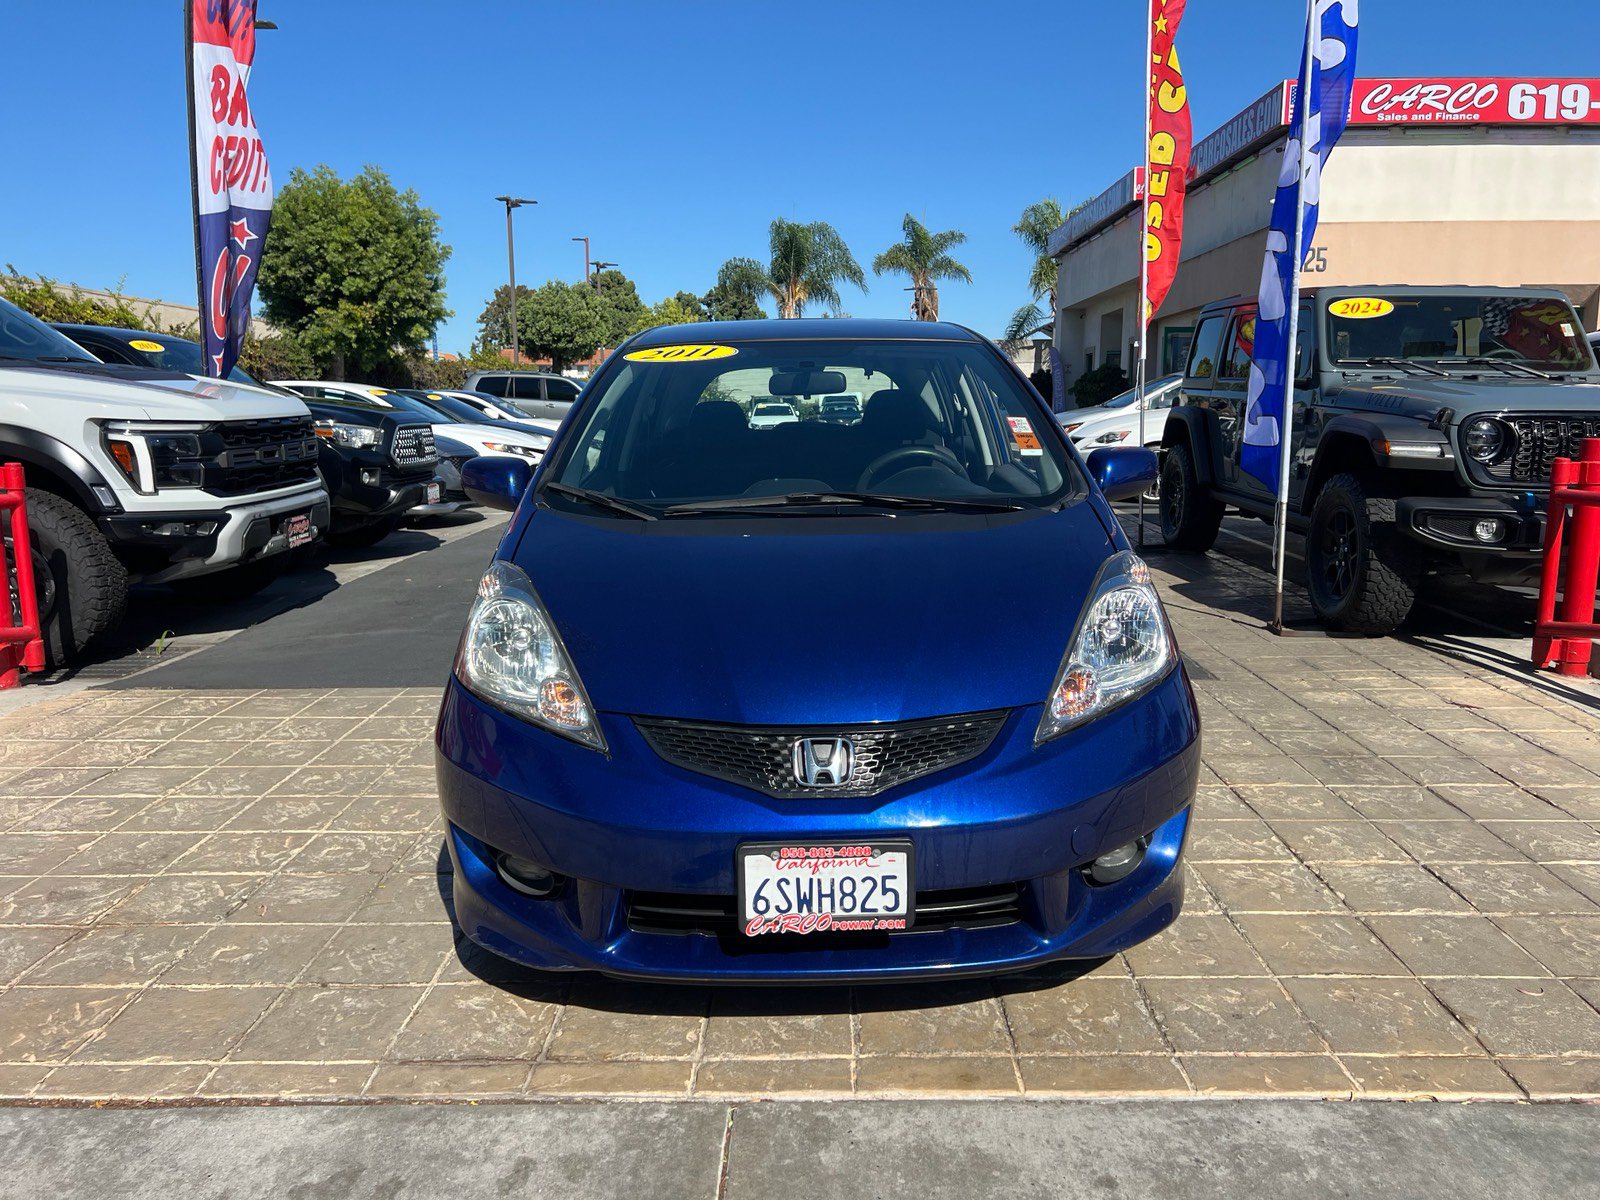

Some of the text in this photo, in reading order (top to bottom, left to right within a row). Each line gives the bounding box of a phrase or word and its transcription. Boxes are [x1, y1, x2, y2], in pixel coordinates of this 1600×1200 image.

[210, 64, 257, 129] BA
[1361, 82, 1499, 115] CARCO
[1377, 112, 1480, 121] Sales and Finance
[1299, 247, 1328, 273] 25
[1340, 301, 1383, 315] 2024
[640, 347, 718, 359] 2011
[775, 857, 881, 875] California
[752, 874, 900, 915] 6SWH825
